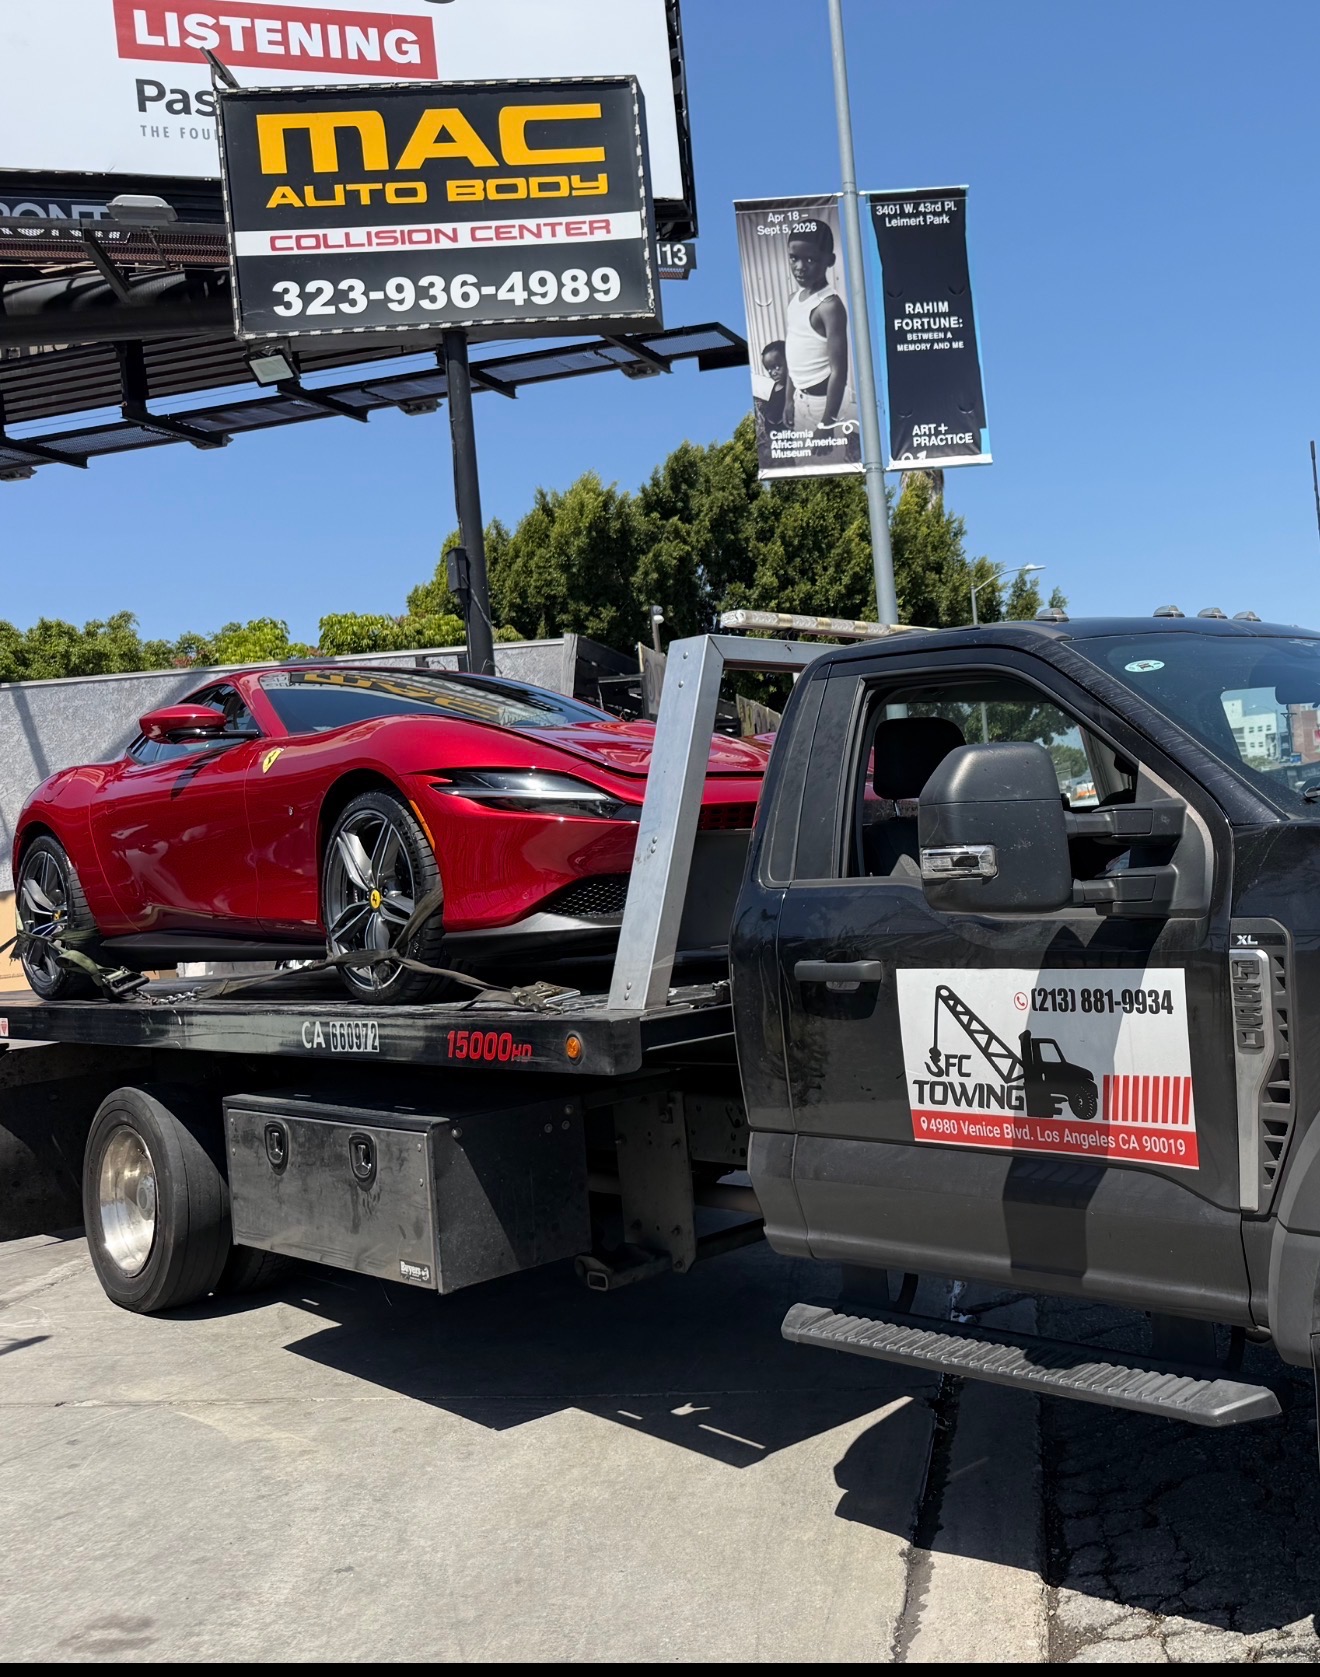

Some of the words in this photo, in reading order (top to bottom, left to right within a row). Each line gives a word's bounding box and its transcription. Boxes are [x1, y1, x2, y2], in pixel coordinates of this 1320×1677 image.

[134, 10, 421, 64] LISTENING
[135, 78, 215, 117] Pas
[140, 125, 170, 138] THE
[180, 127, 217, 140] FOU
[256, 103, 605, 175] MAC
[265, 180, 427, 209] AUTO
[446, 173, 608, 202] BODY
[876, 204, 900, 216] 3401
[903, 203, 917, 214] W.
[918, 202, 942, 213] 43rd
[944, 201, 957, 211] Pl.
[767, 212, 785, 224] Apr
[787, 211, 800, 221] 18
[885, 215, 925, 227] Leimert
[926, 213, 950, 225] Park
[270, 226, 458, 252] COLLISION
[470, 219, 611, 242] CENTER
[757, 225, 781, 236] Sept
[782, 224, 792, 234] 5,
[793, 222, 818, 233] 2026
[272, 266, 621, 317] 323-936-4989
[905, 301, 949, 314] RAHIM
[894, 316, 963, 331] FORTUNE:
[906, 332, 945, 341] BETWEEN
[896, 342, 931, 352] MEMORY
[933, 341, 950, 350] AND
[952, 341, 964, 349] ME
[769, 429, 814, 440] California
[912, 432, 974, 448] PRACTICE
[771, 440, 803, 450] African
[805, 437, 848, 448] American
[771, 449, 812, 459] Museum
[1236, 934, 1259, 945] XL
[1030, 987, 1077, 1012] (213)
[1080, 988, 1174, 1015] 881-9934
[302, 1021, 325, 1048] CA
[331, 1021, 379, 1052] 660972
[912, 1079, 1025, 1111] TOWING
[929, 1119, 958, 1135] 4980
[960, 1121, 1001, 1138] Venice
[1003, 1125, 1034, 1141] Blvd.
[1037, 1128, 1060, 1143] Los
[1063, 1129, 1115, 1150] Angeles
[1118, 1133, 1140, 1151] CA
[1142, 1136, 1186, 1156] 90019
